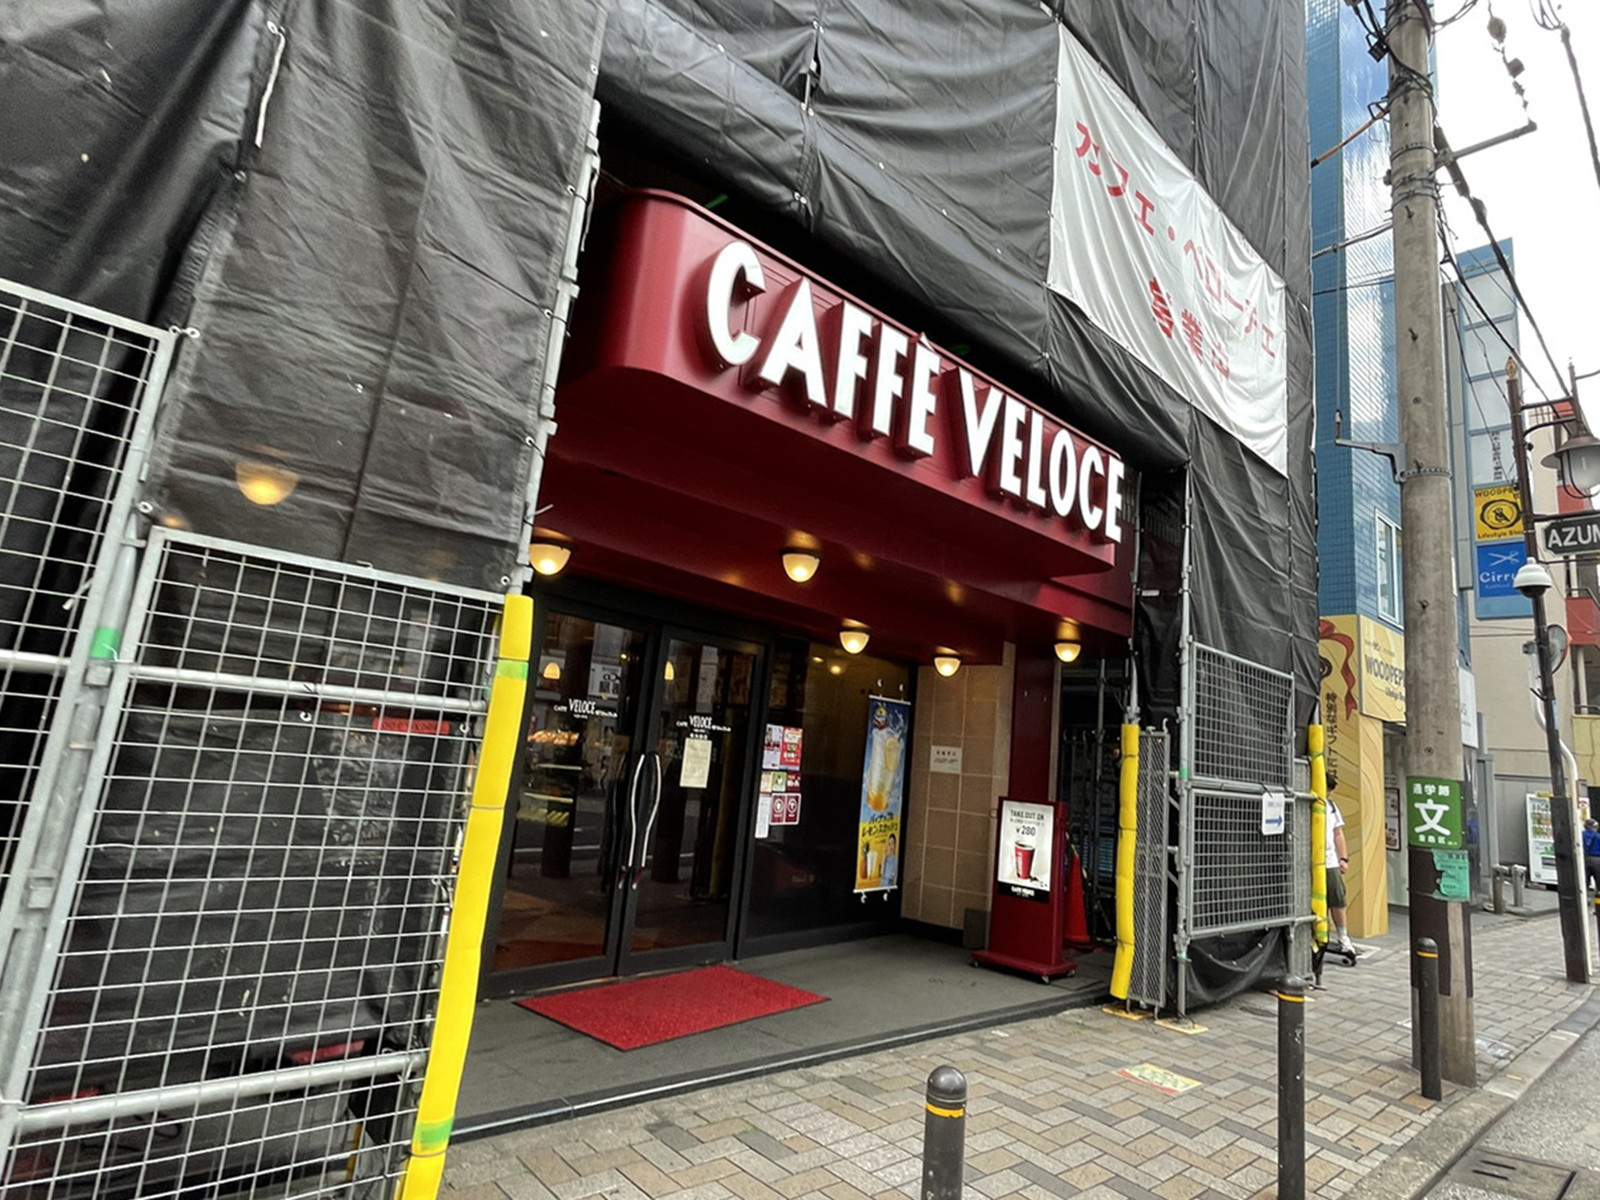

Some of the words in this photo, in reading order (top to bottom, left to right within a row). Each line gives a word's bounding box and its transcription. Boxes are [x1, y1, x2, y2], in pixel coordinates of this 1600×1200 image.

[958, 366, 1126, 543] VELOCE
[1412, 783, 1450, 796] 通学路
[1414, 798, 1451, 836] 文
